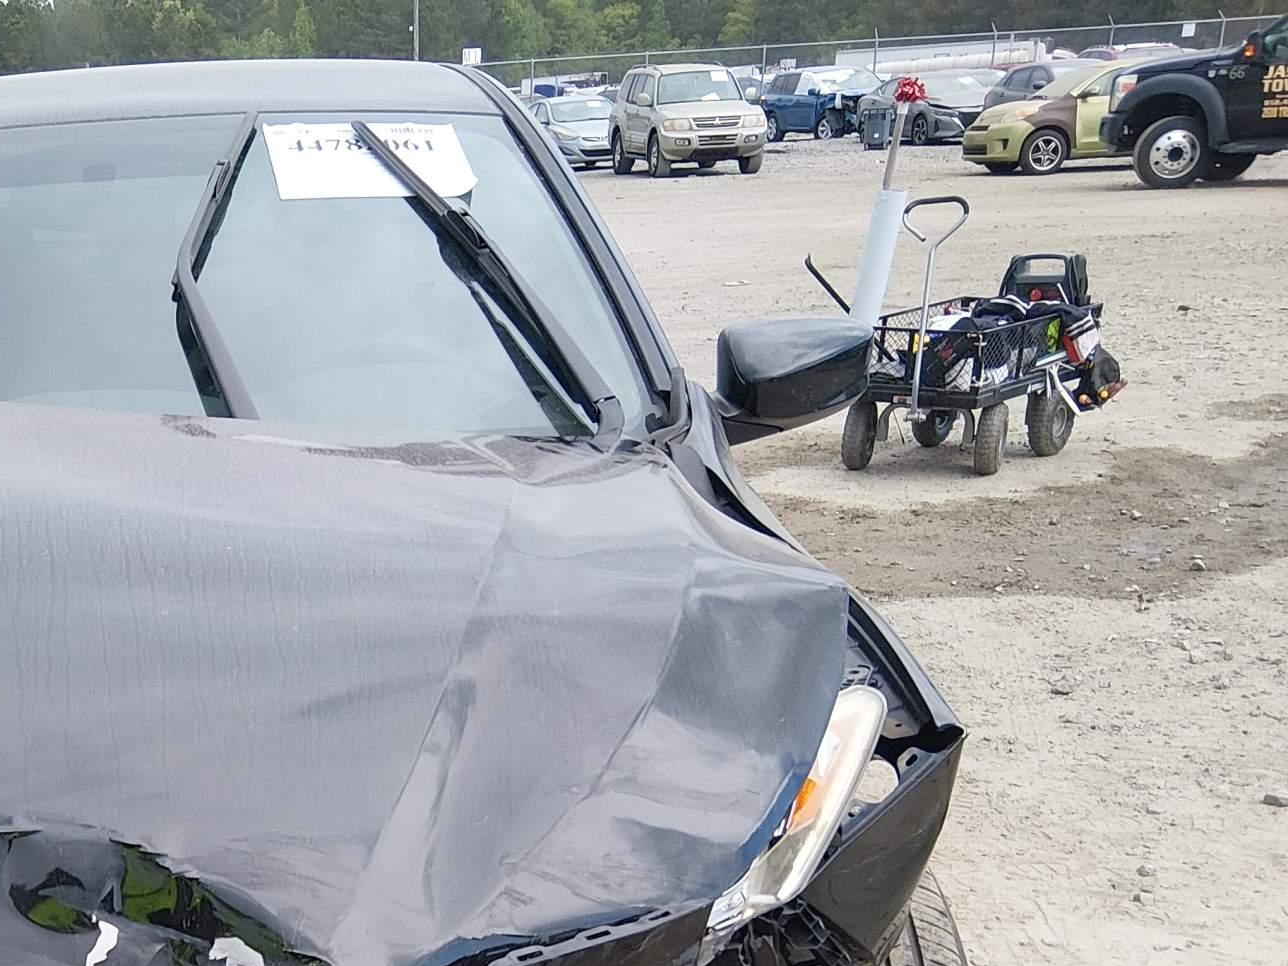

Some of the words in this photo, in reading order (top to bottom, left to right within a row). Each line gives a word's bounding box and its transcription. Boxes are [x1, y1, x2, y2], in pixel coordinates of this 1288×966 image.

[1263, 64, 1288, 79] JA
[1261, 78, 1288, 93] TO
[288, 138, 434, 152] 4478061
